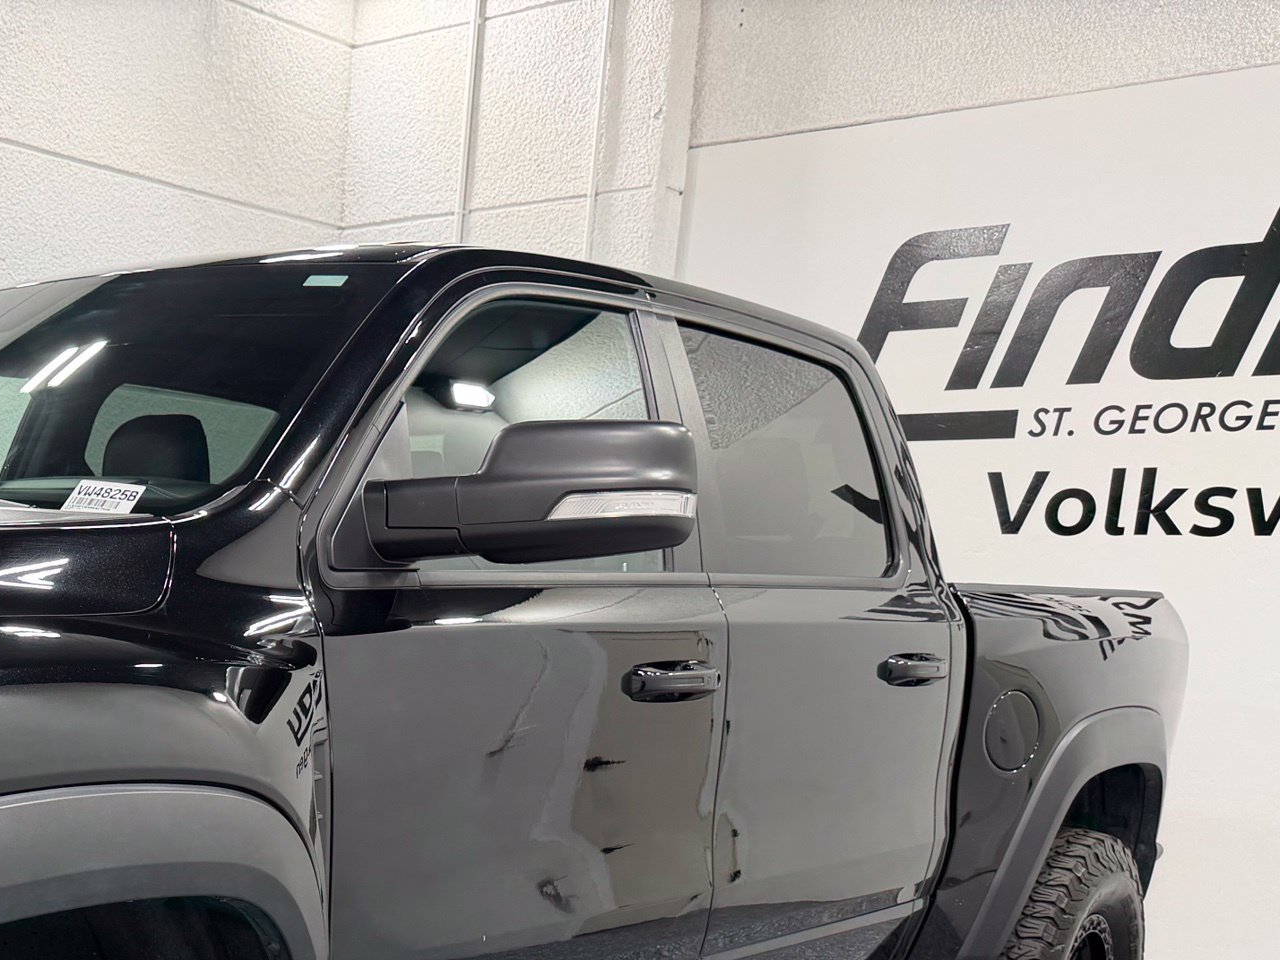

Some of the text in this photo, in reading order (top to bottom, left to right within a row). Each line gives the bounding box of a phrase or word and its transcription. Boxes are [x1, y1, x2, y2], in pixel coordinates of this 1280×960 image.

[857, 206, 1280, 390] Find
[1028, 399, 1280, 438] ST. GEORGE
[77, 485, 139, 502] VW4825B
